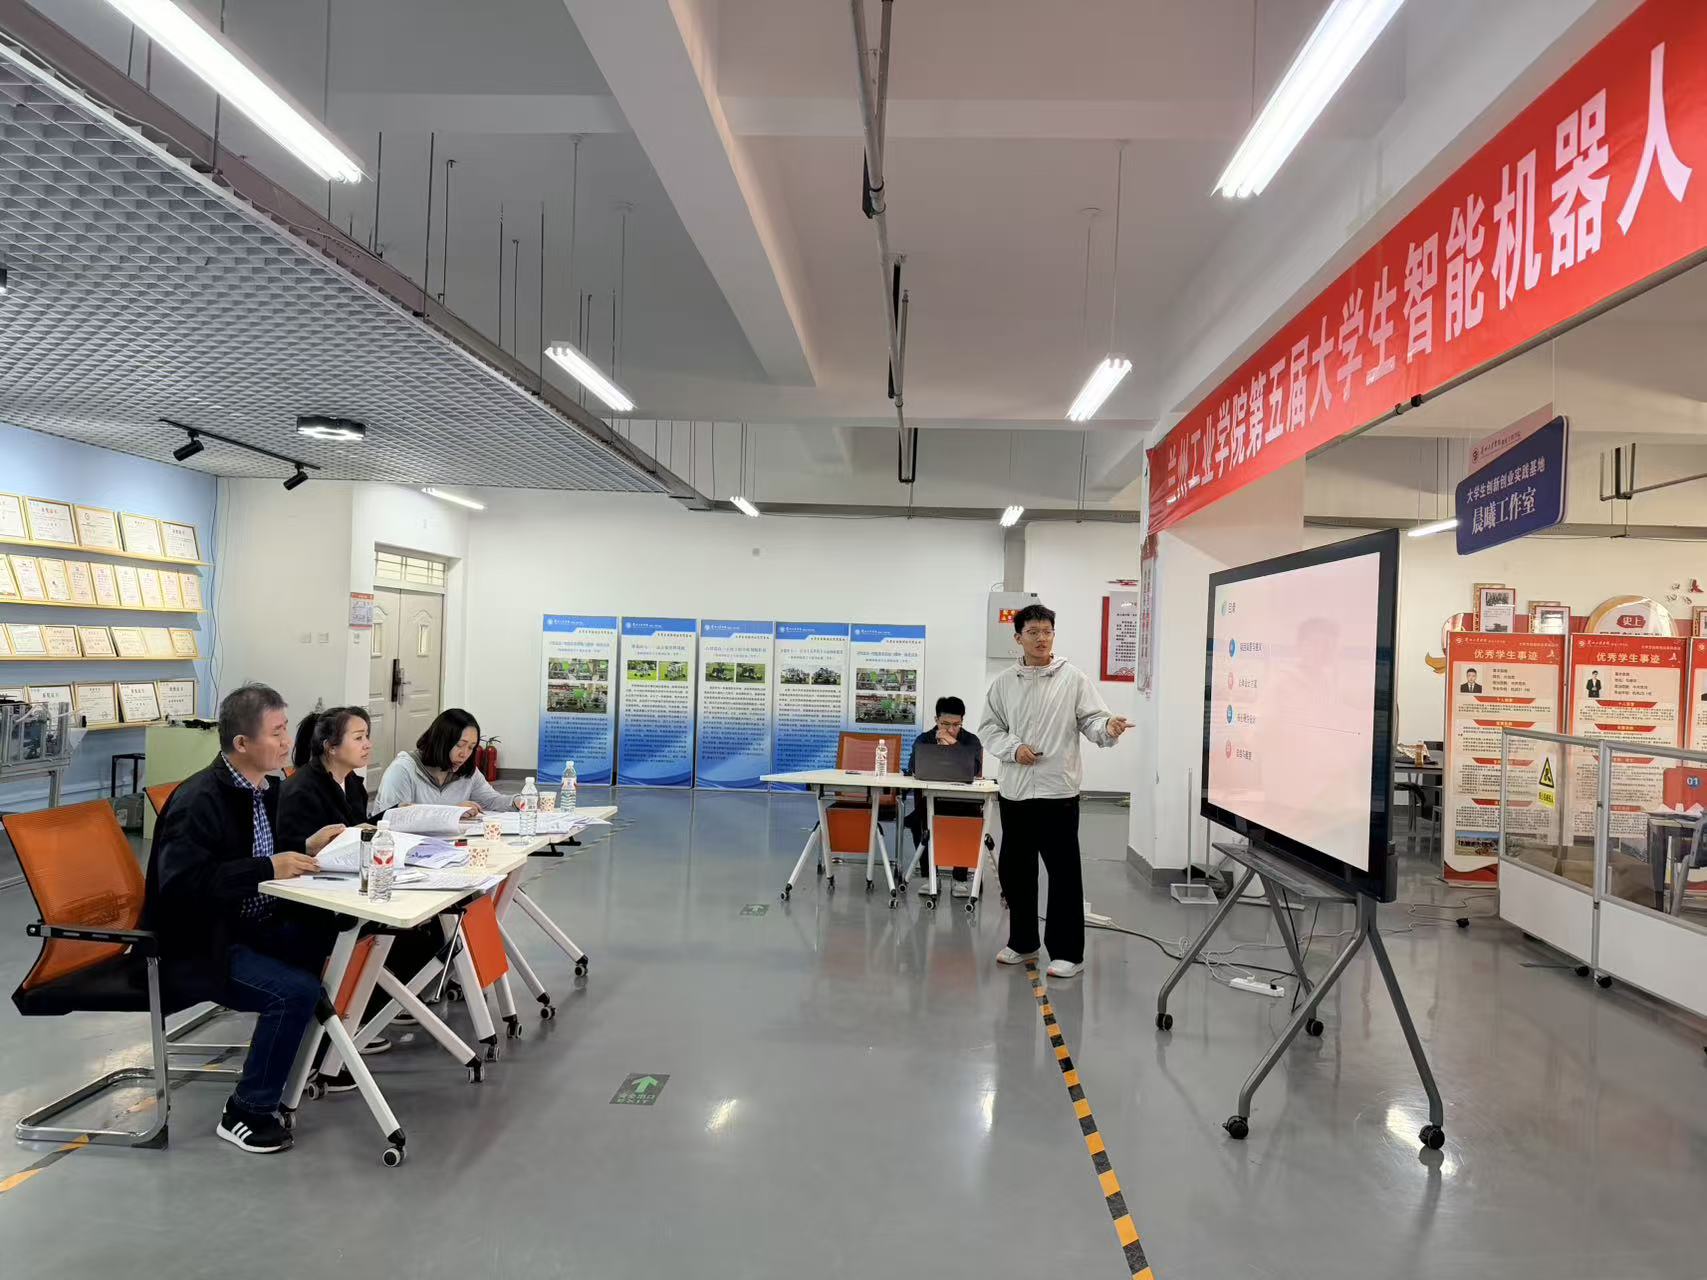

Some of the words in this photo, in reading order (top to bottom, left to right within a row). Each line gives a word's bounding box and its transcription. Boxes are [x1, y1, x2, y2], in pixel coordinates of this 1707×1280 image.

[1166, 41, 1693, 507] 兰州工业学院第五届大学生智能机器人
[1466, 456, 1546, 504] 大学生创新创业实践基地
[1471, 486, 1537, 535] 晨曦工作室
[1474, 649, 1538, 661] 优秀学生事迹
[1596, 652, 1661, 664] 优秀学生事迹
